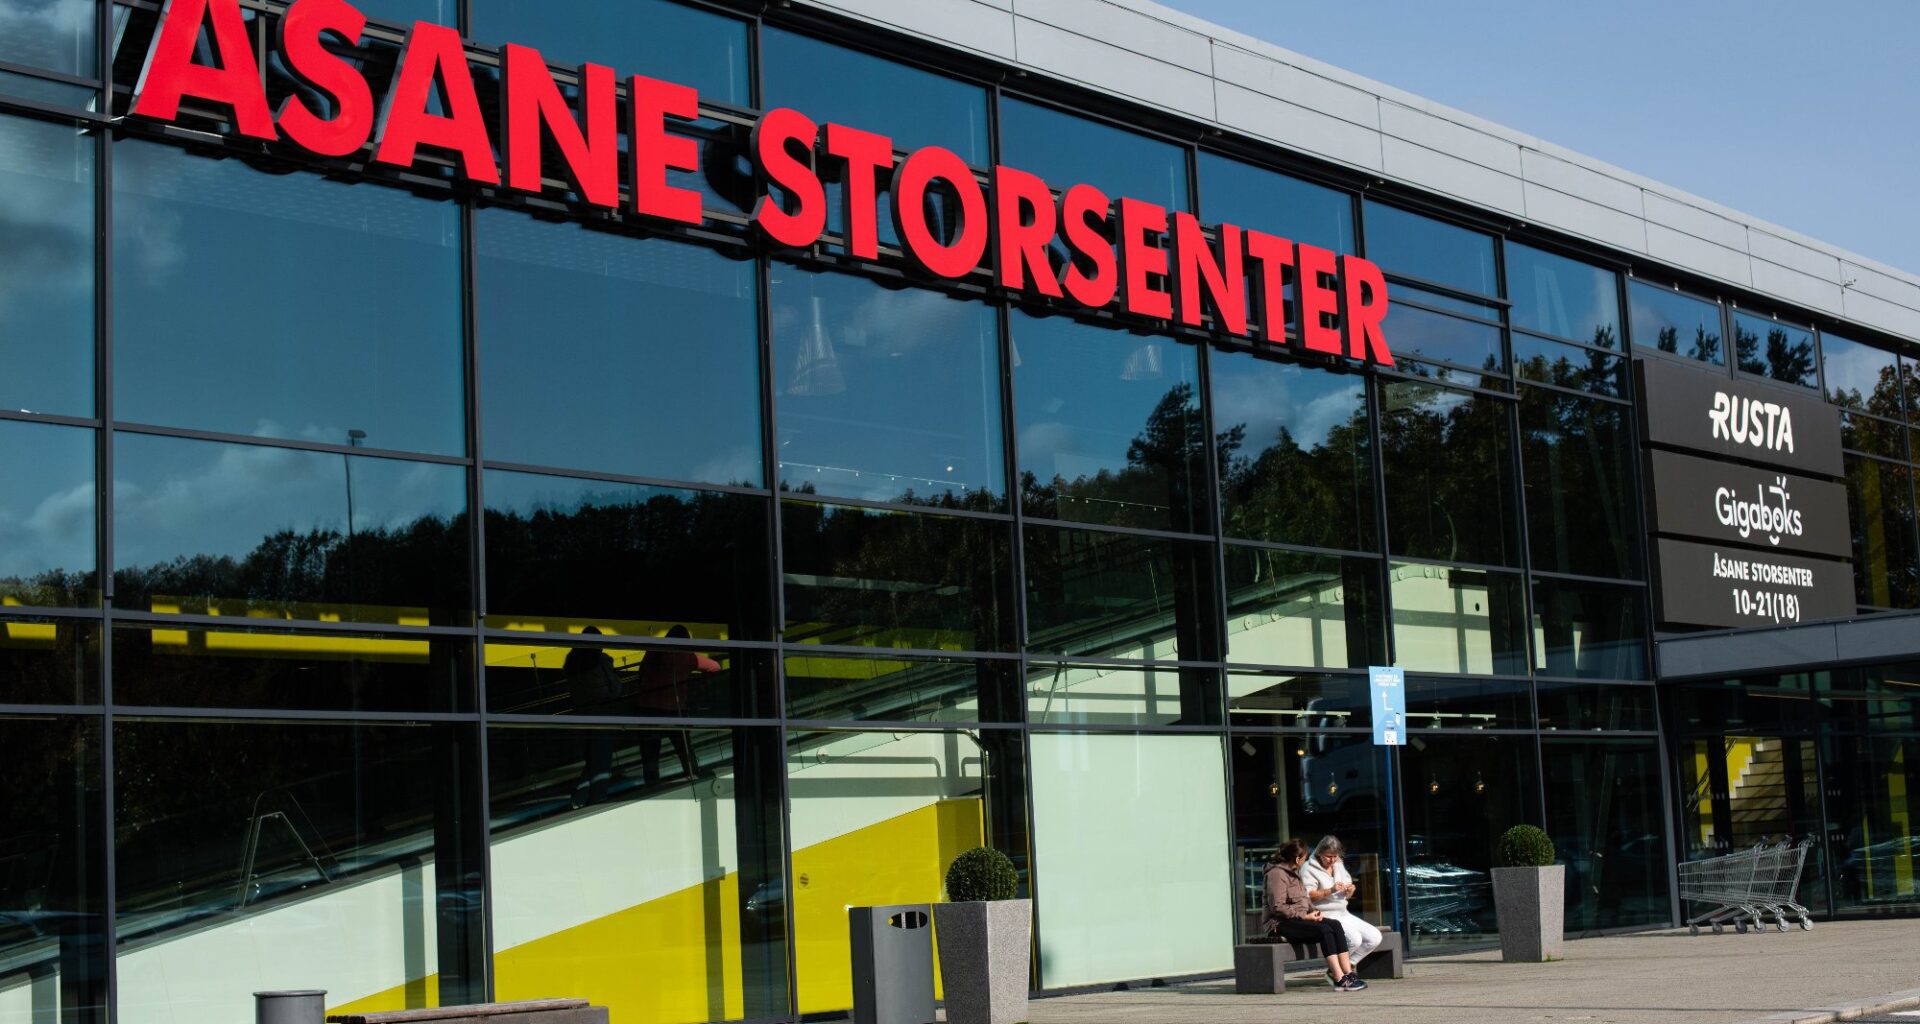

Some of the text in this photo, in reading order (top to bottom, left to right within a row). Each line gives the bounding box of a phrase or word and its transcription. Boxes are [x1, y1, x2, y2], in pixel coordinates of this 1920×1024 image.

[753, 107, 1395, 366] STORSENTER
[1708, 391, 1794, 454] RUSTA
[1714, 482, 1803, 540] Gigaboks
[1713, 552, 1814, 588] ÅSANE STORSENTER
[1732, 588, 1800, 624] 10-21(18)
